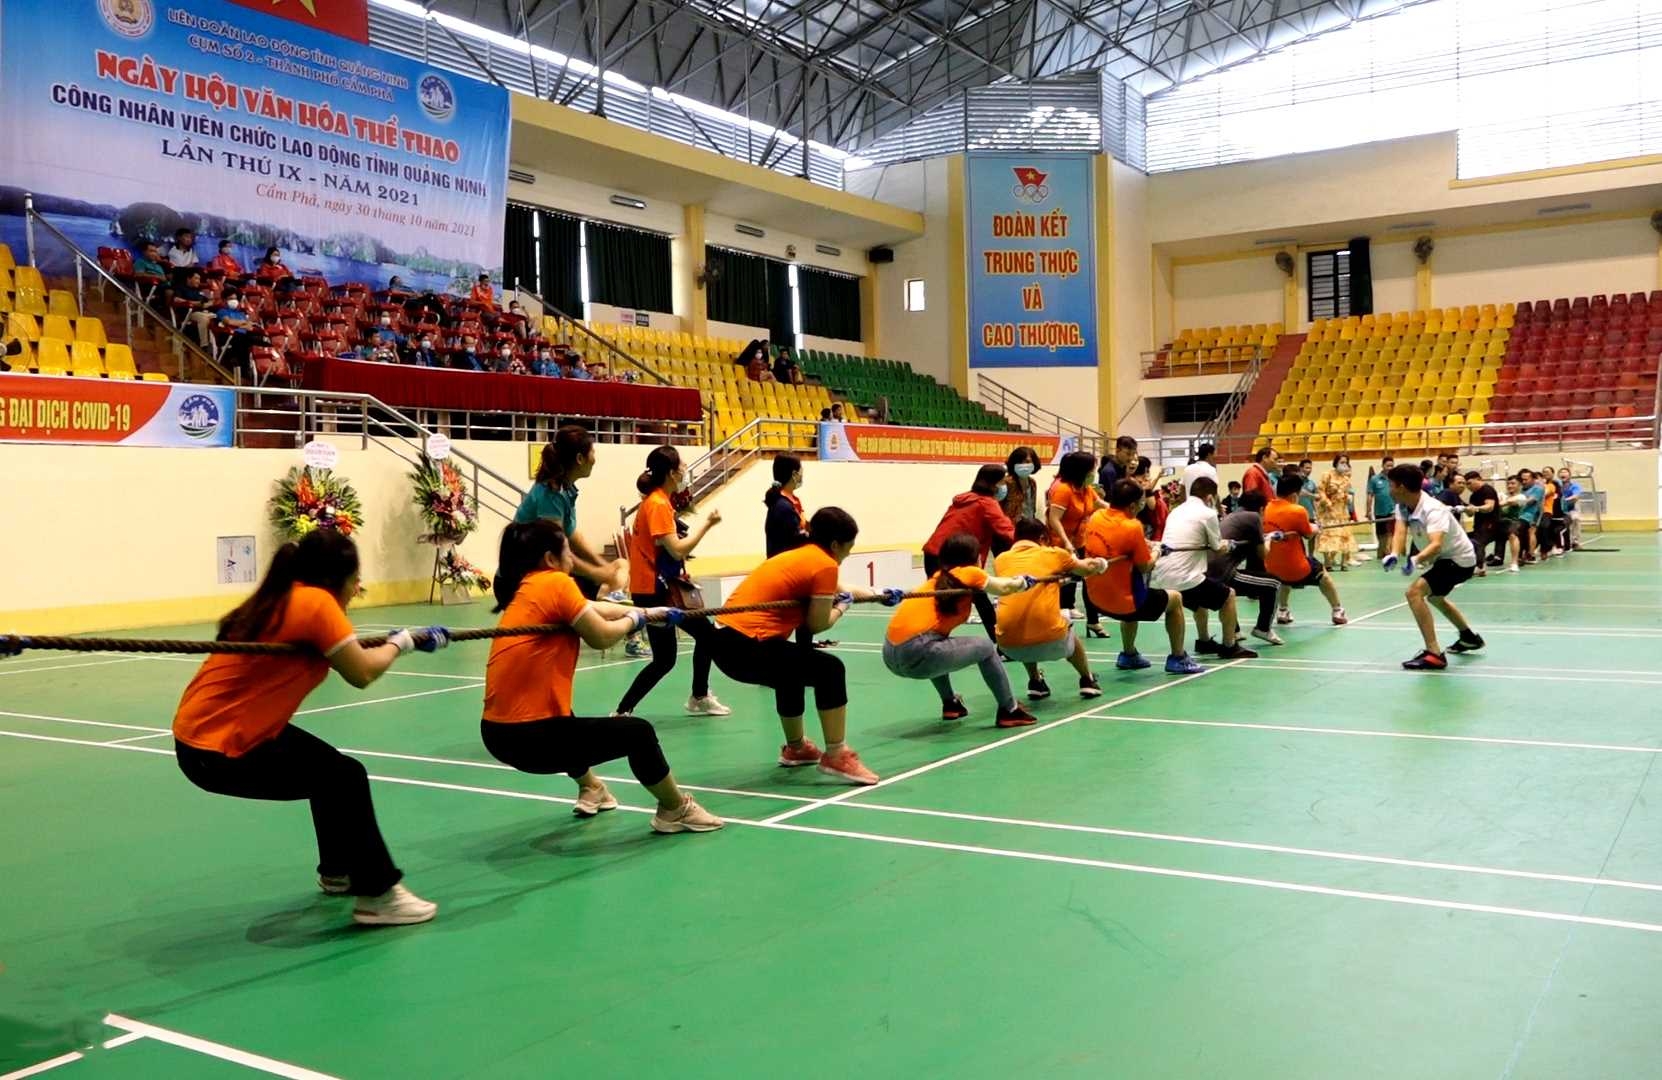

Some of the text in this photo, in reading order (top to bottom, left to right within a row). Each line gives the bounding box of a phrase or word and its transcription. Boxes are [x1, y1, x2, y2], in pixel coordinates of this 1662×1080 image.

[168, 8, 197, 27] LIÊN
[198, 18, 241, 41] ĐOÀN
[241, 29, 268, 48] LAO
[381, 70, 409, 89] NINH
[222, 43, 244, 60] SỐ
[245, 50, 255, 63] 2
[312, 69, 339, 87] PHỐ
[97, 50, 459, 163] NGÀY HỘI VĂN HÓA THỂ THAO
[52, 83, 487, 198] CÔNG NHÂN VIÊN CHỨC LAO ĐỘNG TỈNH QUẢNG NINH
[162, 137, 213, 163] LẦN
[221, 152, 271, 175] THỨ
[278, 163, 301, 182] IX
[323, 172, 371, 197] NĂM
[378, 185, 419, 206] 2021
[256, 183, 287, 200] Cẩm
[356, 202, 370, 216] 30
[410, 214, 422, 226] 10
[451, 222, 476, 237] 2021
[993, 207, 1068, 237] ĐOÀN KẾT
[983, 249, 1078, 278] TRUNG THỰC
[1023, 283, 1043, 309] VÀ
[983, 322, 1083, 351] CAO THƯỢNG.
[10, 398, 33, 434] ĐẠI
[37, 399, 69, 436] DỊCH
[72, 401, 131, 431] COVID-19
[866, 561, 874, 588] 1
